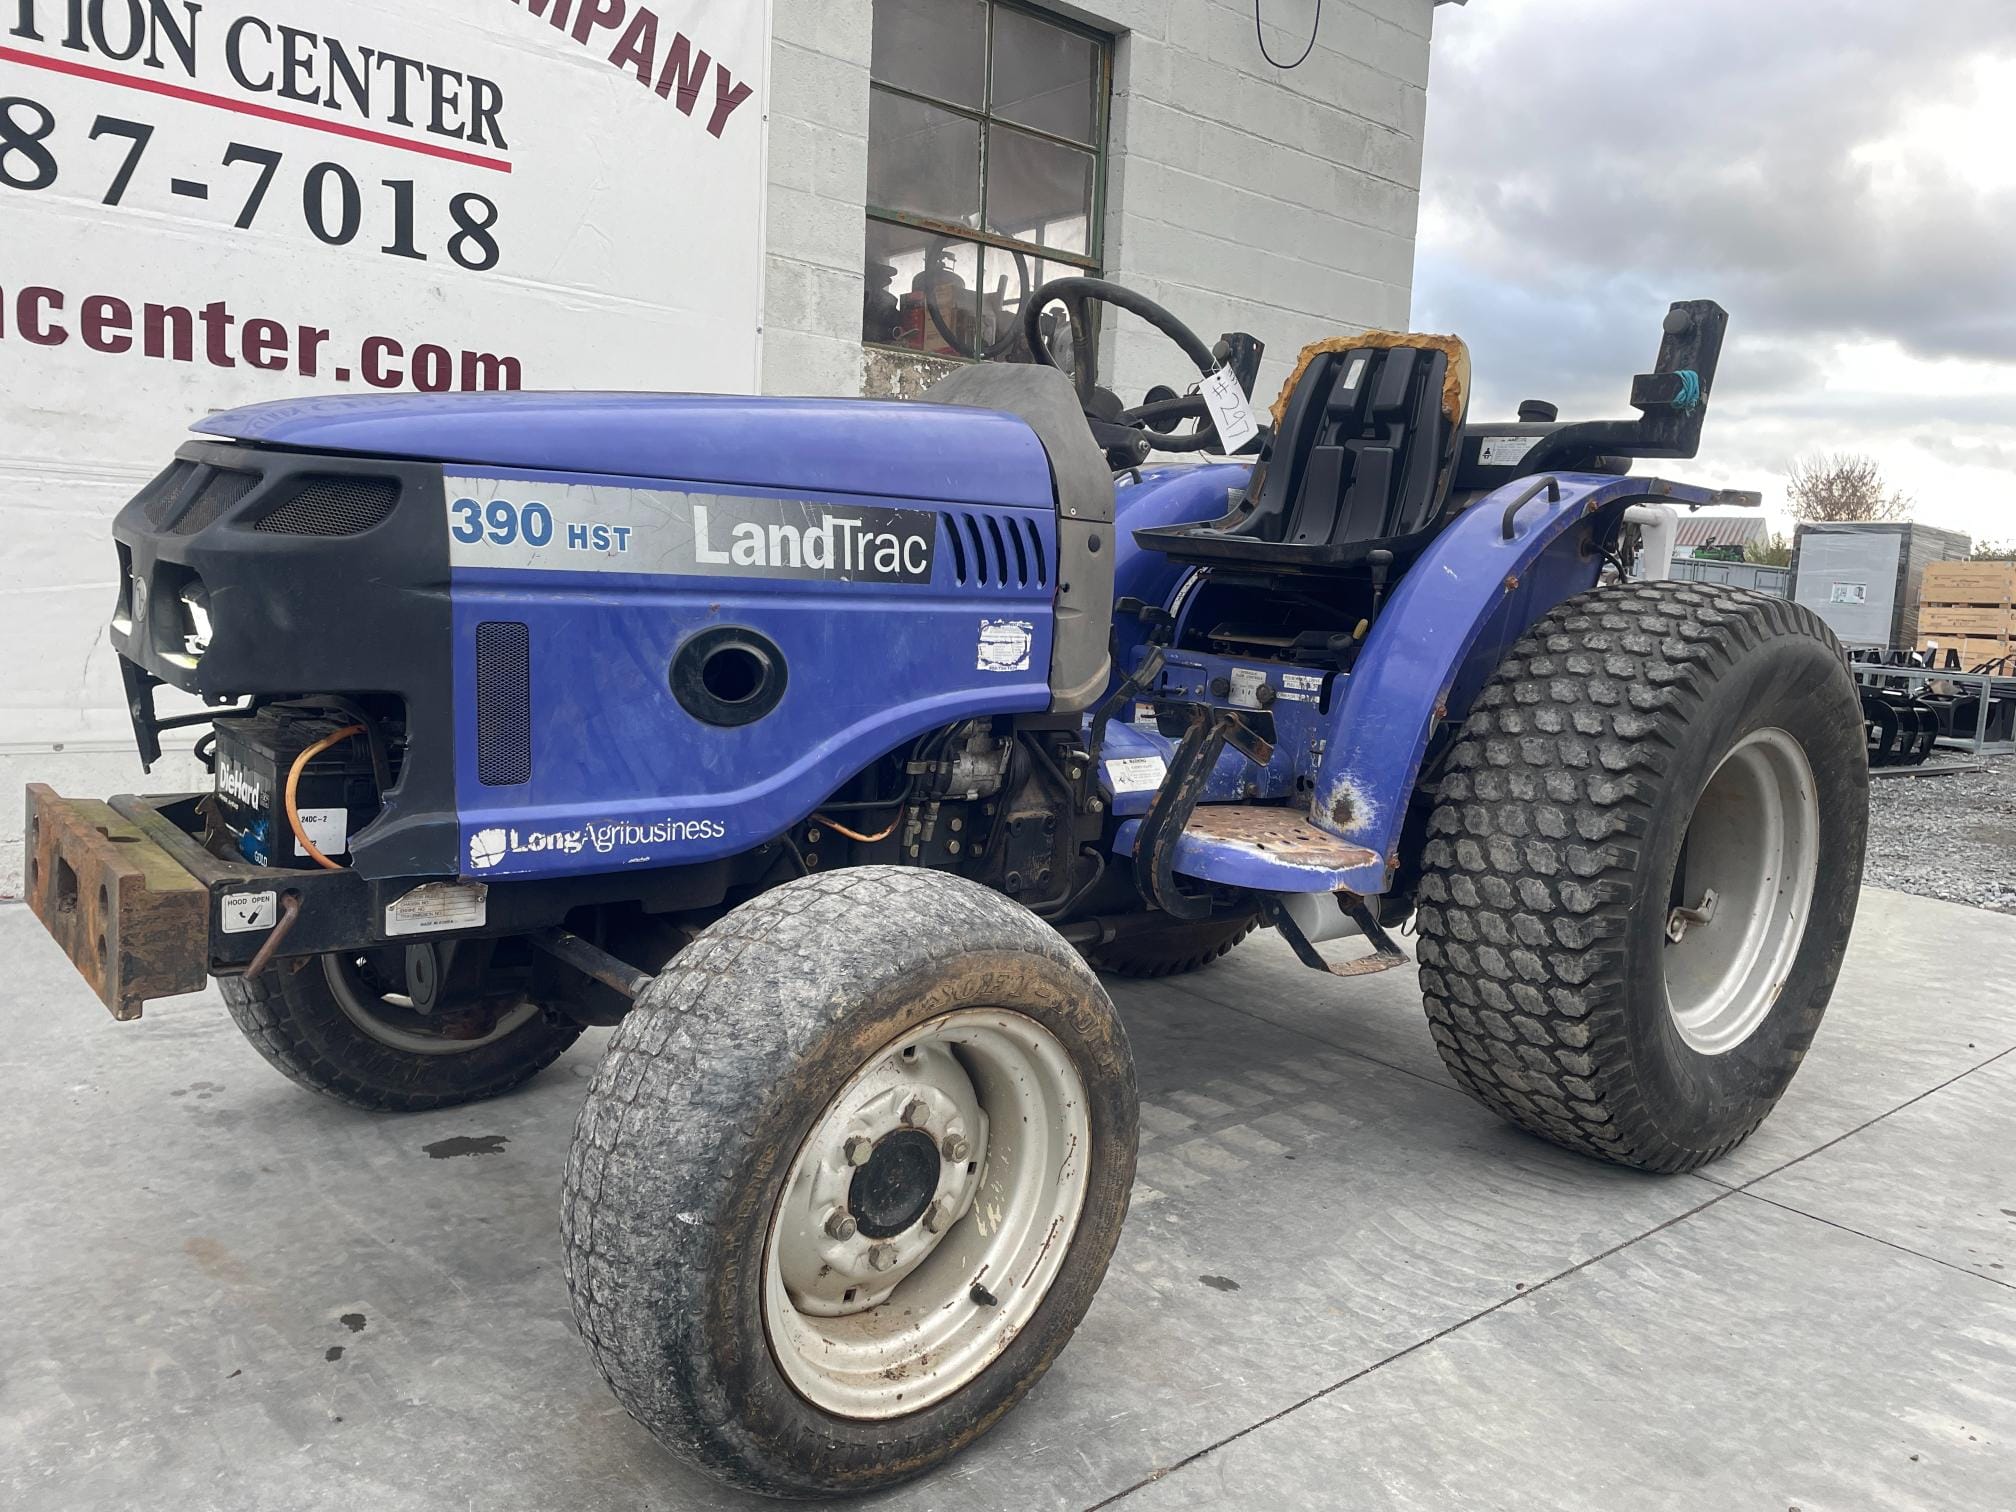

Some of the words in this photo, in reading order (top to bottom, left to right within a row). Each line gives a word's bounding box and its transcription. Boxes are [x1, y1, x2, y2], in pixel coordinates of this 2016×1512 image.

[225, 15, 508, 151] CENTER
[0, 96, 501, 272] 87-7018
[0, 285, 522, 393] center.com
[1212, 382, 1250, 439] #297
[451, 497, 555, 549] 390
[566, 523, 633, 553] HST
[693, 504, 928, 575] LandTrac
[219, 761, 260, 811] DieHard
[254, 850, 268, 868] GOLD
[510, 817, 725, 854] LongAgribusiness
[227, 898, 248, 907] HOOD
[251, 895, 270, 904] OPEN
